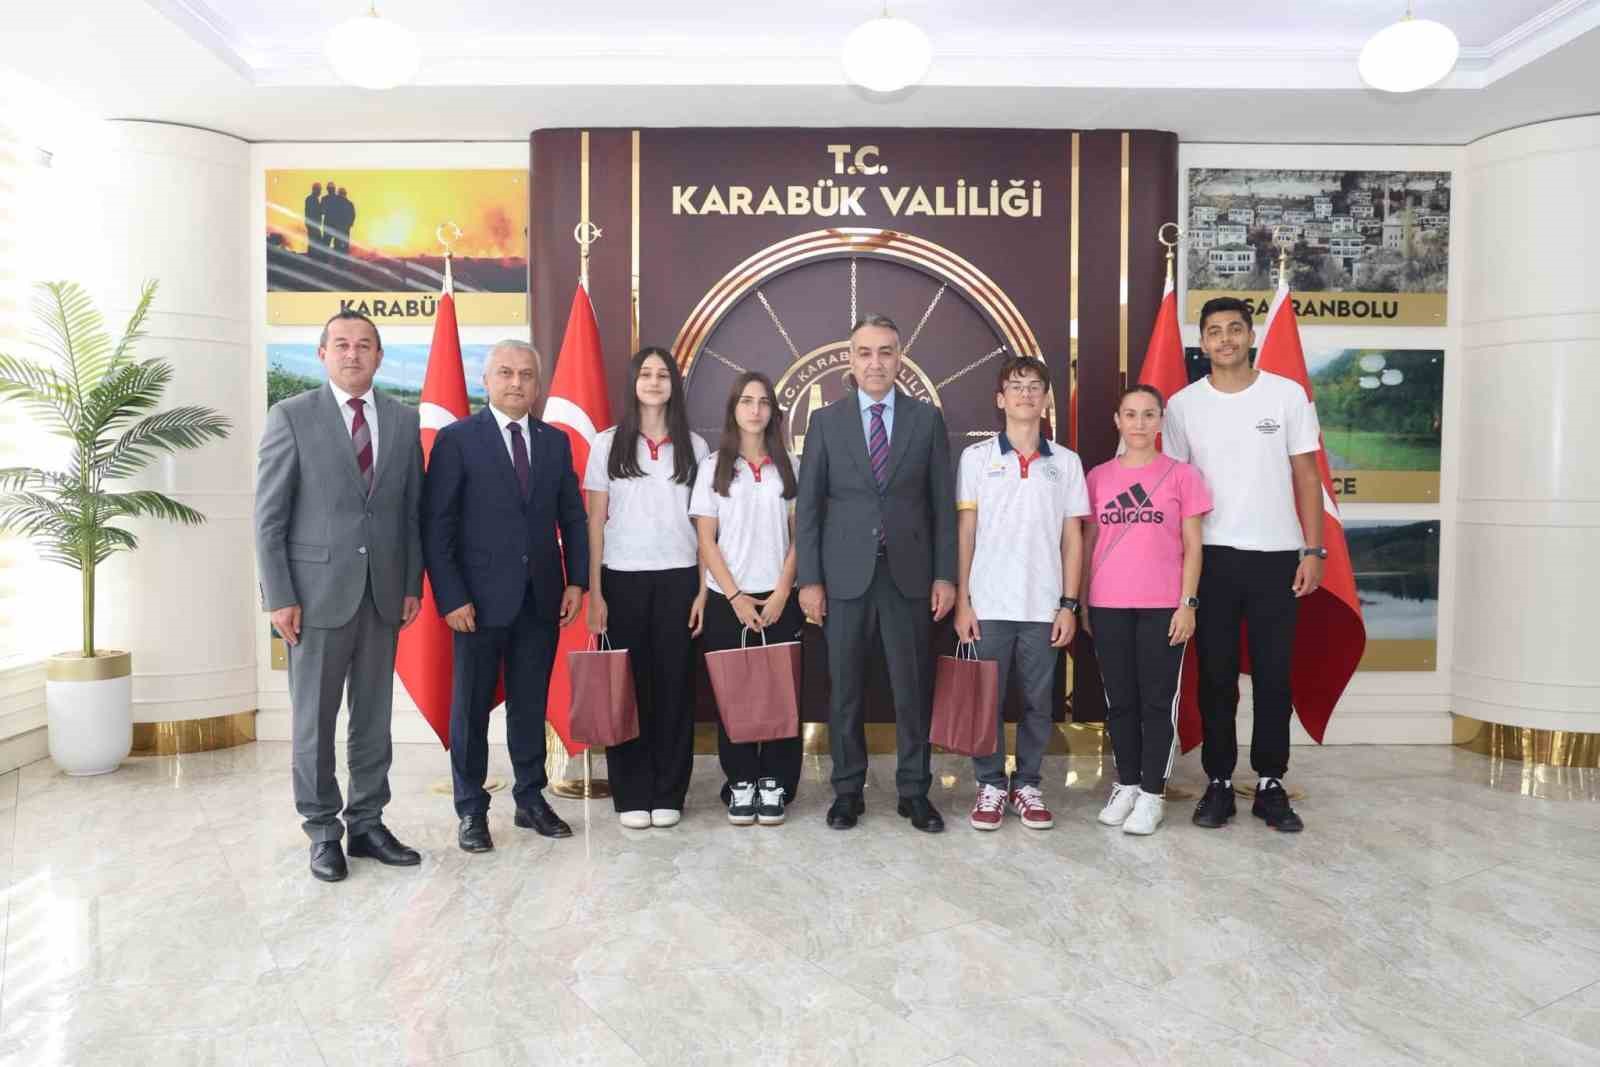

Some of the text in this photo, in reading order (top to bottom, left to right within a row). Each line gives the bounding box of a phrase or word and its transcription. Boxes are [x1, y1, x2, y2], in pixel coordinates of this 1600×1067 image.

[827, 144, 889, 175] T.C.
[672, 178, 1042, 217] KARABÜK VALİLİĞİ
[340, 295, 441, 317] KARABÜ
[1244, 298, 1399, 319] SARANBOLU
[798, 351, 849, 382] KARAB
[1100, 508, 1164, 525] adidas
